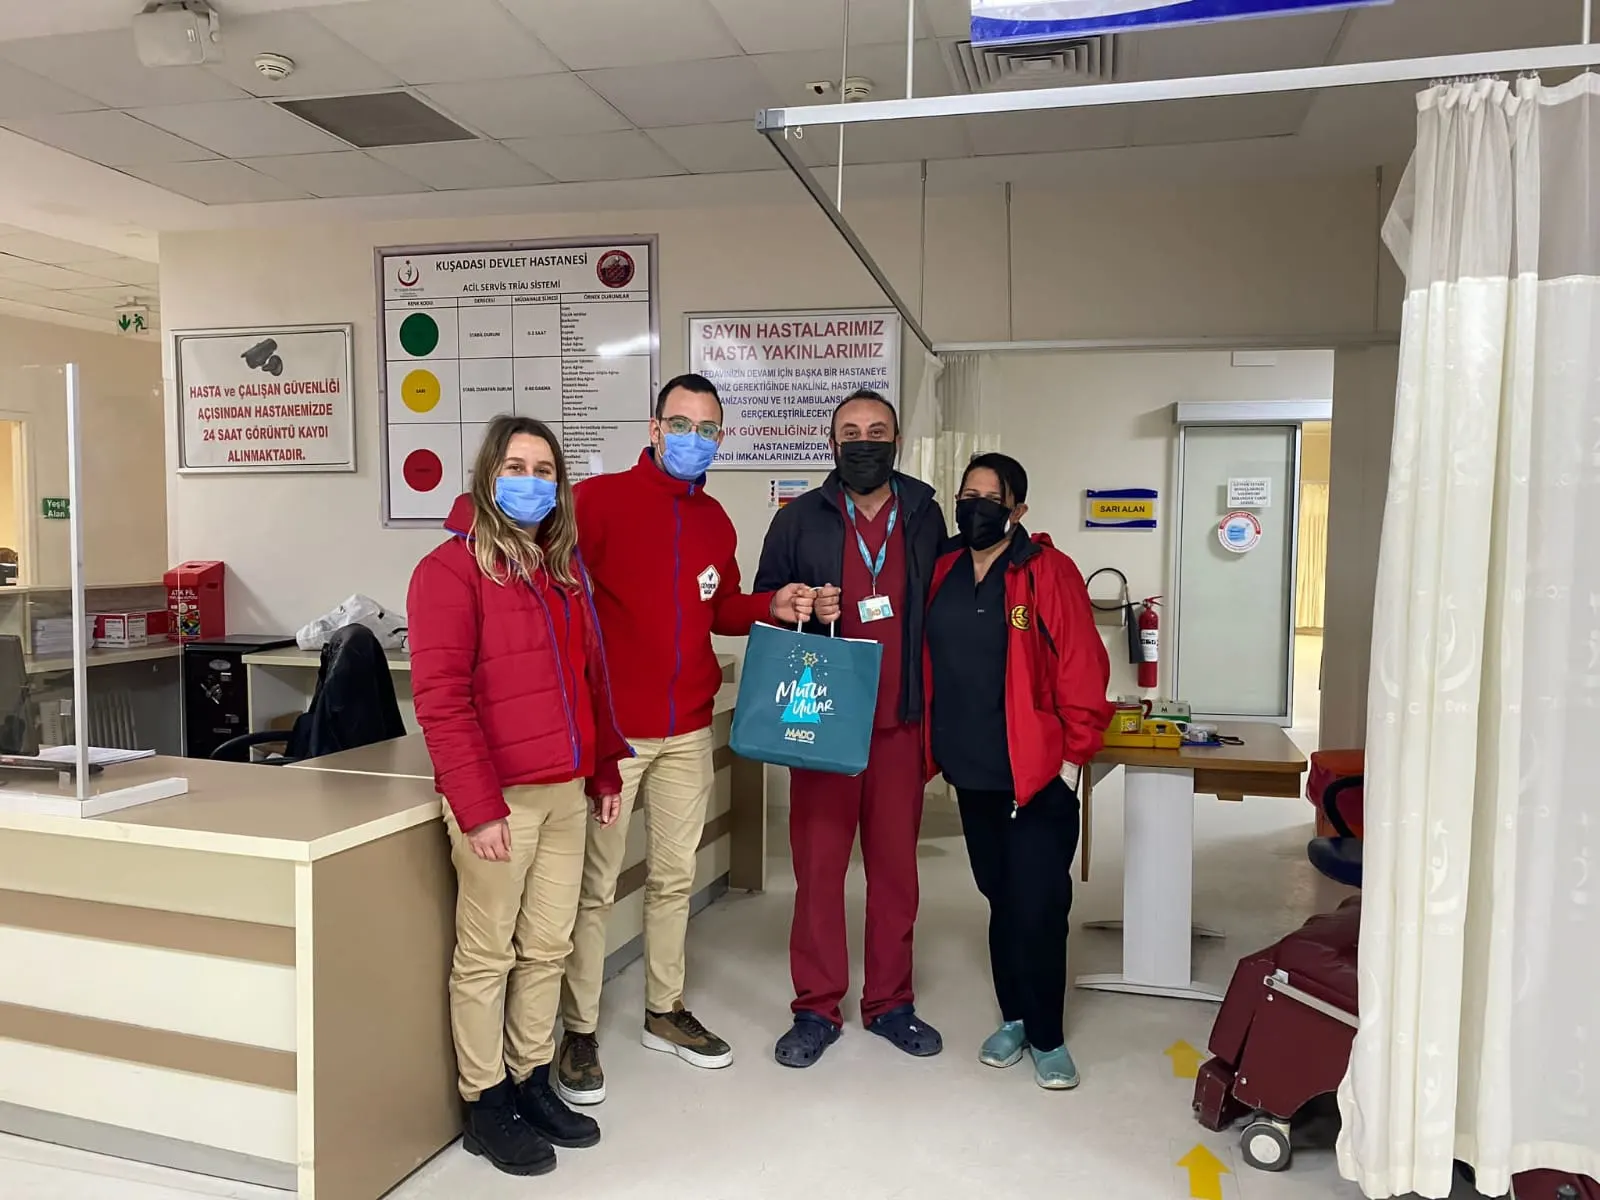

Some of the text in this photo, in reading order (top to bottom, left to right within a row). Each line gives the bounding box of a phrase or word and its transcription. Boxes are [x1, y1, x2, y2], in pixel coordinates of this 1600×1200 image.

[436, 252, 588, 273] KUŞADASI DEVLET HASTANESİ
[463, 279, 561, 292] ACİL SERVİS TRİAJ SİSTEMİ
[702, 320, 884, 340] SAYIN HASTALARIMIZ
[703, 342, 884, 361] HASTA YAKINLARIMIZ
[747, 369, 776, 378] DEVAMI
[776, 368, 793, 379] İÇİN
[795, 368, 823, 379] BAŞKA
[824, 366, 838, 377] BİR
[839, 367, 887, 376] HASTANEYE
[190, 378, 340, 400] HASTA ve ÇALIŞAN GÜVENLİĞİ
[733, 380, 790, 391] GEREKTİĞİNDE
[831, 379, 889, 390] HASTANEMİZİN
[720, 395, 769, 405] ANİZASYONU
[770, 396, 781, 404] VE
[783, 396, 796, 404] 112
[198, 401, 333, 422] AÇISINDAN HASTANEMİZDE
[203, 424, 328, 441] 24 SAAT GÖRÜNTÜ KAYDI
[739, 424, 817, 437] GÜVENLİĞİNİZ
[753, 441, 829, 451] HASTANEMİZDEN
[227, 448, 306, 462] ALINMAKTADIR.
[713, 451, 734, 461] ENDİ
[736, 451, 814, 461] İMKANLARINIZLA
[47, 510, 66, 518] Alan
[1100, 505, 1145, 513] SARI ALAN
[784, 727, 816, 741] MADO
